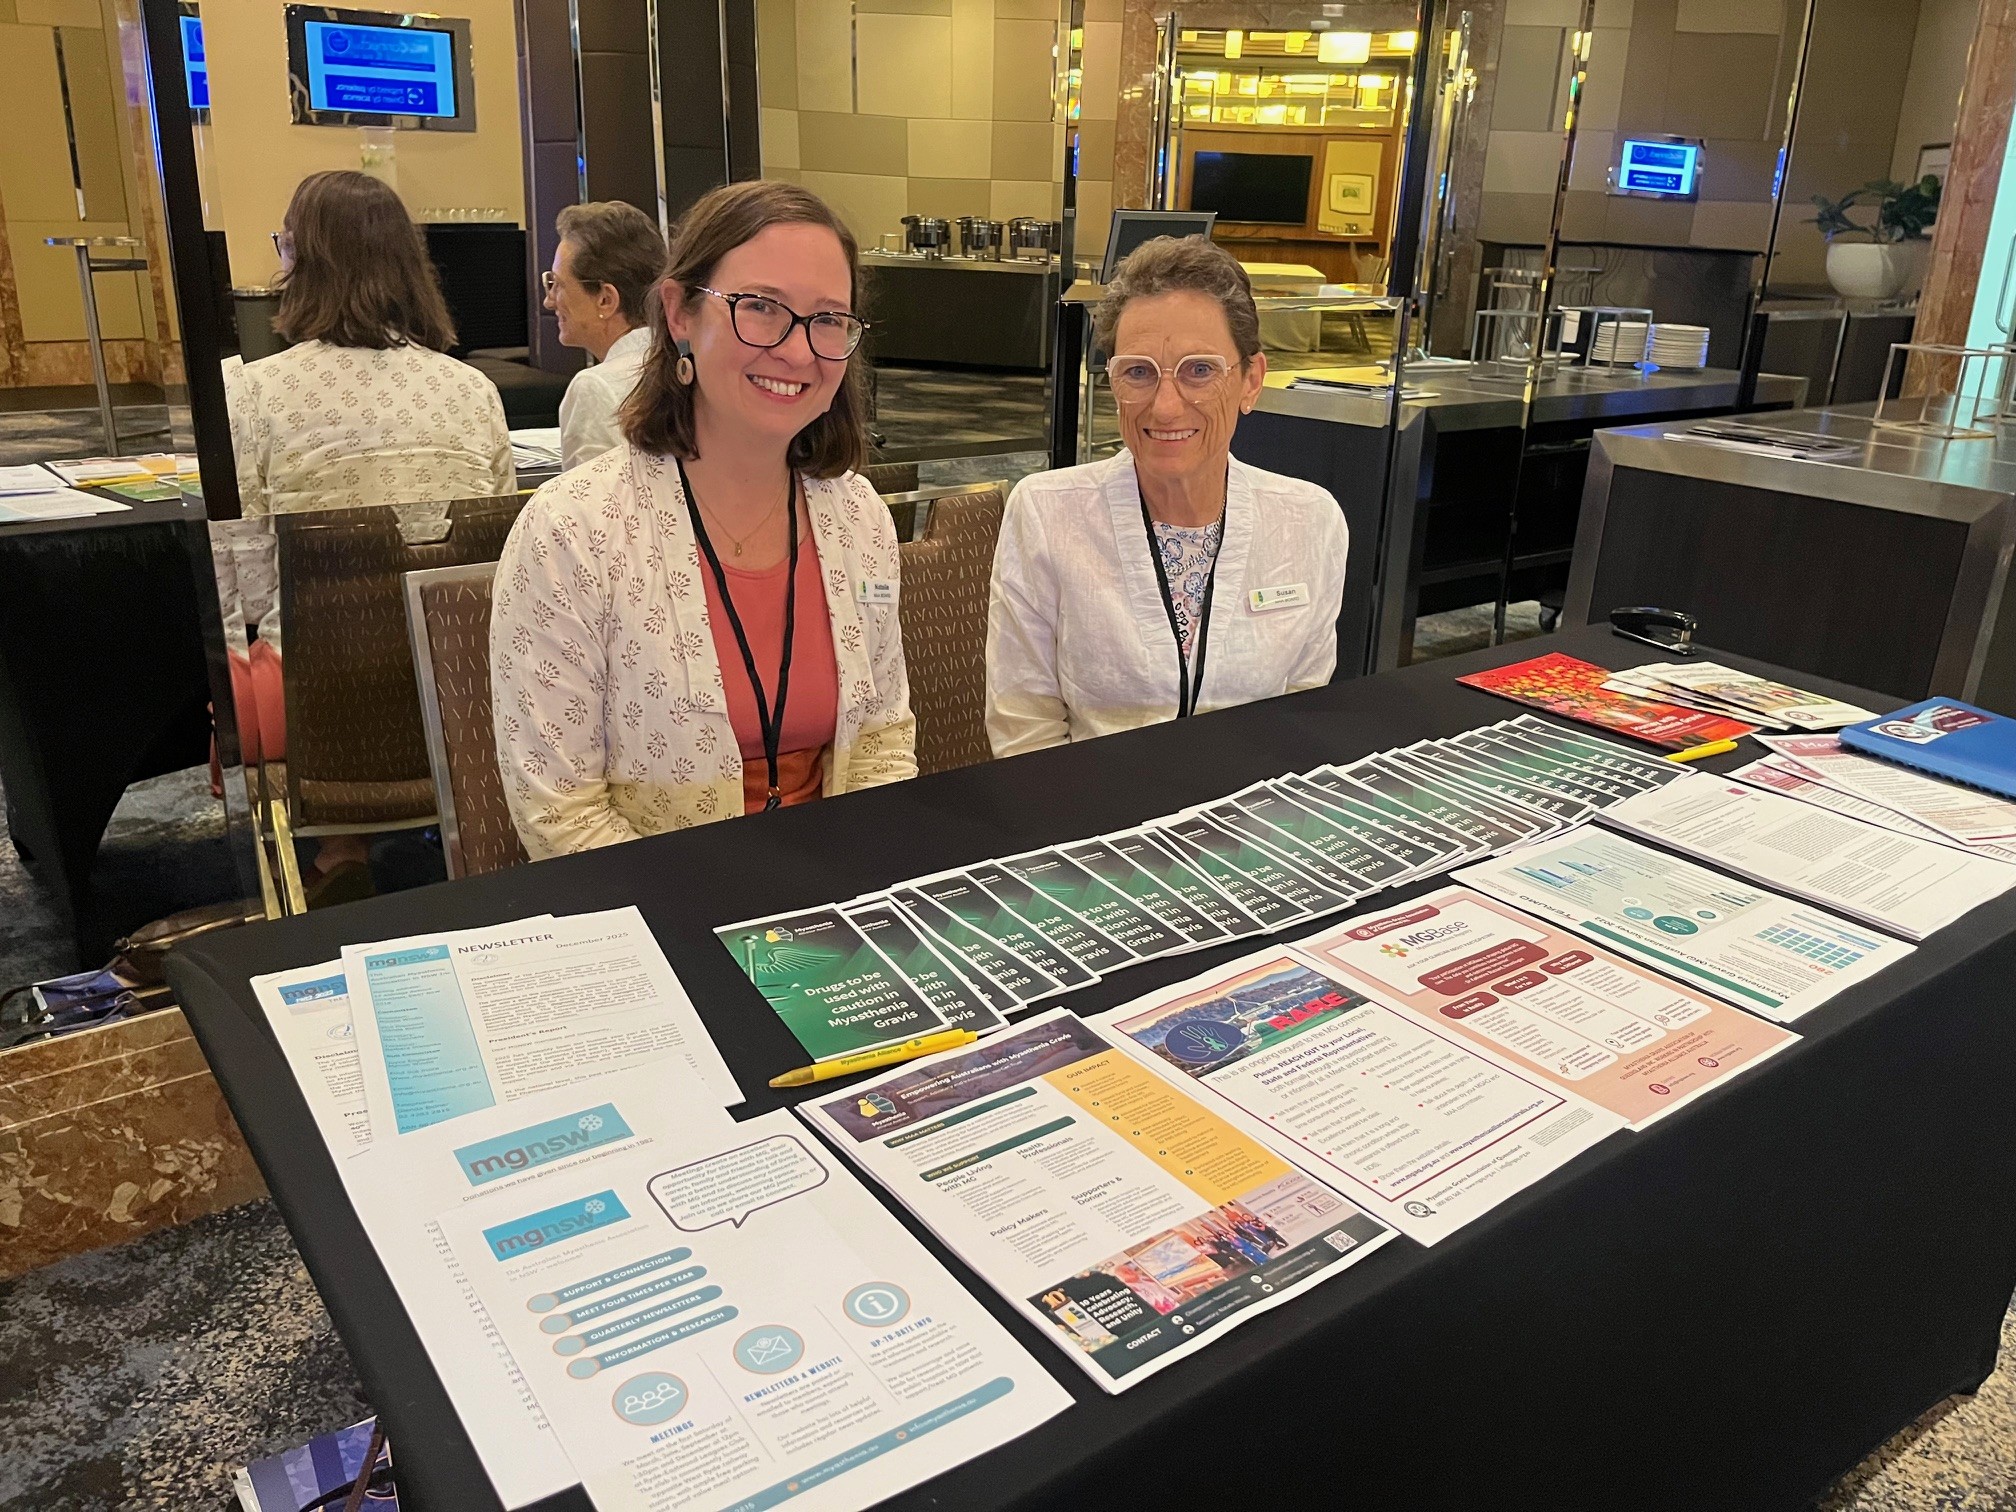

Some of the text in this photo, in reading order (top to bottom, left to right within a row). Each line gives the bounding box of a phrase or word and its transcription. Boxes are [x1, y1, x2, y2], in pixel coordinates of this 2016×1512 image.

[1276, 589, 1296, 597] Susan
[1088, 900, 1119, 914] to be
[1145, 890, 1160, 901] be
[1519, 895, 1570, 918] TERUMO
[458, 934, 553, 953] NEWSLETTER
[555, 932, 629, 949] December 2025
[1008, 931, 1025, 942] be
[1126, 931, 1164, 948] Gravis
[1399, 921, 1468, 946] MGBase
[965, 942, 981, 953] be
[1428, 949, 1450, 959] CLINICIAN
[1449, 944, 1463, 952] ABOUT
[1463, 932, 1495, 947] PARTICIPATING
[368, 951, 430, 969] mgnsw
[1594, 916, 1790, 999] Myasthenia Gravis (MG) Australian Survey 2022
[804, 972, 881, 996] Drugs to be
[918, 970, 938, 982] be
[823, 981, 890, 1004] used with
[831, 990, 899, 1014] caution in
[942, 988, 956, 1000] in
[828, 1001, 908, 1027] Myasthenia
[873, 1011, 918, 1028] Gravis
[1268, 992, 1349, 1032] RARE
[488, 1025, 567, 1043] President's Report
[840, 1046, 902, 1066] Myasthenia Alliance
[1211, 1074, 1232, 1083] This
[1248, 1052, 1280, 1068] ongoing
[1277, 1040, 1305, 1054] request
[1310, 1031, 1326, 1039] the
[1321, 1025, 1339, 1033] MG
[1252, 1066, 1279, 1079] Please
[1277, 1054, 1304, 1068] REACH
[1303, 1046, 1319, 1056] OUT
[1328, 1036, 1344, 1046] your
[1342, 1027, 1366, 1038] Local,
[1261, 1032, 1376, 1085] State and Federal Representatives
[900, 1078, 950, 1099] Empowering
[950, 1064, 992, 1080] Australians
[991, 1057, 1009, 1066] with
[1008, 1042, 1049, 1060] Myasthenia
[1049, 1033, 1071, 1044] Gravis
[1066, 1059, 1110, 1079] OUR IMPACT
[871, 1111, 906, 1126] Myasthenia
[470, 1128, 590, 1177] mgnsw
[1016, 1142, 1044, 1155] Health
[1021, 1137, 1073, 1159] Professionals
[462, 1185, 504, 1202] Donations
[516, 1174, 536, 1184] have
[536, 1168, 556, 1178] given
[557, 1161, 578, 1171] since
[578, 1156, 591, 1164] our
[591, 1146, 628, 1160] beginning
[635, 1137, 654, 1146] 1982
[662, 1172, 705, 1189] opportunity
[718, 1161, 738, 1170] those
[739, 1155, 755, 1163] with
[769, 1143, 786, 1152] their
[664, 1185, 690, 1196] carers,
[690, 1176, 714, 1187] family
[715, 1170, 730, 1179] and
[730, 1162, 755, 1173] friends
[764, 1153, 778, 1161] talk
[779, 1146, 793, 1156] and
[670, 1165, 704, 1179] Meetings
[704, 1157, 727, 1168] create
[738, 1142, 770, 1156] excellent
[670, 1193, 687, 1203] gain
[693, 1183, 716, 1193] better
[717, 1164, 770, 1185] understanding
[777, 1153, 798, 1163] living
[935, 1163, 993, 1188] People Living
[942, 1176, 977, 1193] with MG
[1071, 1180, 1115, 1200] Supporters
[1077, 1190, 1107, 1205] Donors
[496, 1208, 594, 1254] mgnsw
[989, 1209, 1048, 1237] Policy Makers
[505, 1224, 649, 1276] The Australian Myasthenia Association
[563, 1279, 602, 1297] SUPPORT
[613, 1255, 671, 1279] CONNECTION
[576, 1272, 694, 1318] MEET FOUR TIMES PER YEAR
[1079, 1288, 1112, 1307] 10 Years
[1086, 1288, 1131, 1314] celebrating
[590, 1294, 701, 1339] QUARTERLY NEWSLETTERS
[1093, 1296, 1133, 1319] Advocacy,
[1098, 1302, 1137, 1323] Research,
[1105, 1307, 1143, 1329] and Unity
[604, 1334, 669, 1362] INFORMATION
[679, 1312, 724, 1333] RESEARCH
[870, 1316, 932, 1347] UP-TO-DATE INFO
[1126, 1328, 1161, 1349] CONTACT
[744, 1375, 799, 1402] NEWSLETTERS
[808, 1356, 842, 1375] WEBSITE
[650, 1420, 694, 1443] MEETINGS
